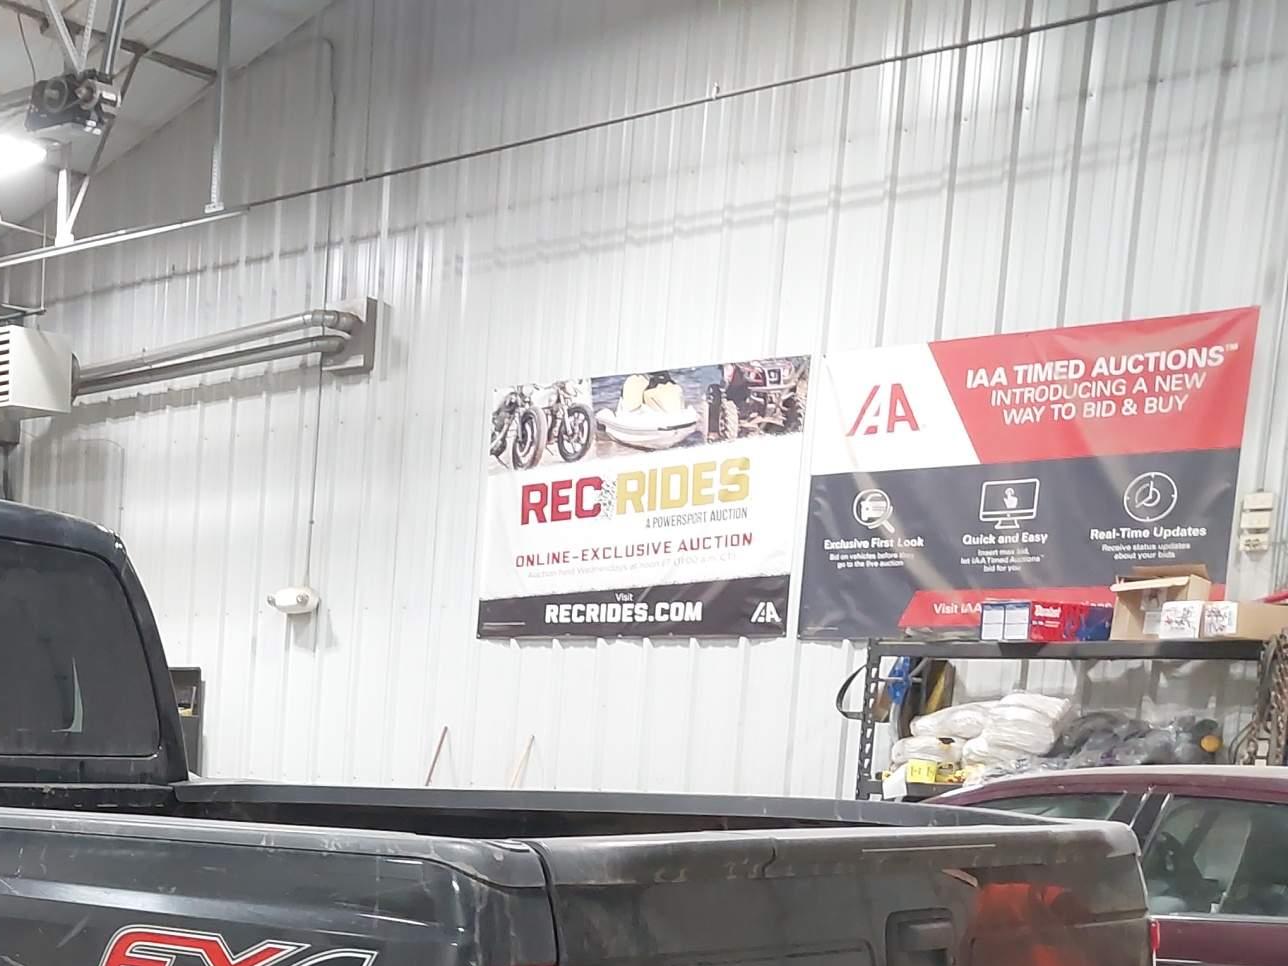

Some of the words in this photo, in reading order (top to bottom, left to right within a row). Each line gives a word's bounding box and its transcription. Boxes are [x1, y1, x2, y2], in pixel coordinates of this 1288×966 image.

[966, 367, 1008, 388] IAA
[1013, 360, 1085, 384] TIMED
[991, 380, 1126, 406] INTRODUCING
[1132, 377, 1148, 394] A
[1154, 371, 1207, 392] NEW
[1003, 407, 1046, 425] WAY
[1051, 404, 1076, 421] TO
[1083, 400, 1115, 419] BID
[1122, 398, 1138, 416] &
[1144, 394, 1189, 414] BUY
[520, 476, 604, 525] REC
[616, 457, 750, 515] RIDES
[710, 506, 748, 523] AUCTION
[824, 538, 869, 550] Exclusive
[871, 537, 894, 548] First
[897, 536, 925, 547] Look
[962, 533, 996, 545] Quick
[998, 532, 1019, 544] and
[1021, 531, 1048, 544] Easy
[1090, 527, 1150, 540] Real-Time
[1153, 526, 1207, 540] Updates
[516, 541, 671, 568] ONLINE-EXCLUSIVE
[677, 532, 753, 553] AUCTION
[615, 592, 634, 602] Visit
[545, 601, 703, 624] RECRIDES.COM
[933, 602, 960, 615] Visit
